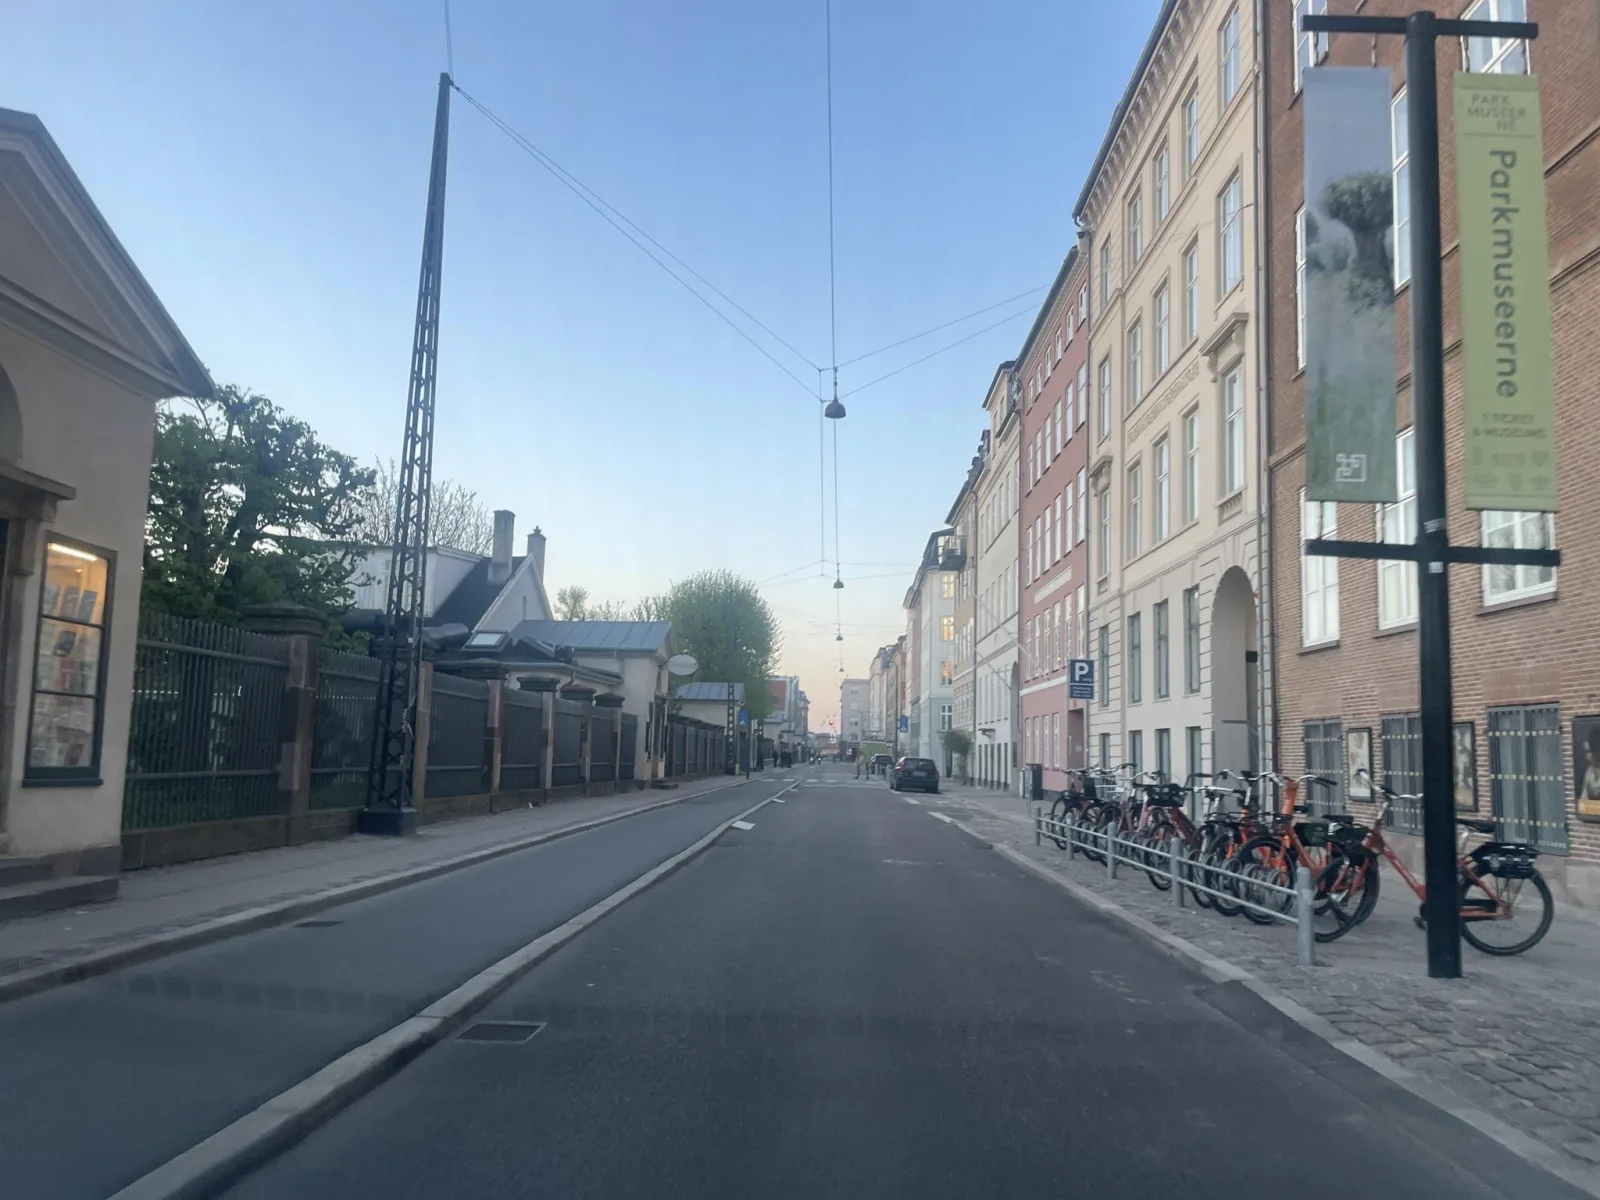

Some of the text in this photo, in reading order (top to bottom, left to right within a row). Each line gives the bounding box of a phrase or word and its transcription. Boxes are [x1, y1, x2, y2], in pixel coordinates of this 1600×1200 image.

[1472, 93, 1509, 105] PARK
[1467, 107, 1526, 119] MUSEER
[1496, 120, 1518, 131] NE
[1489, 149, 1520, 399] Parkmuseerne
[1074, 662, 1089, 681] P
